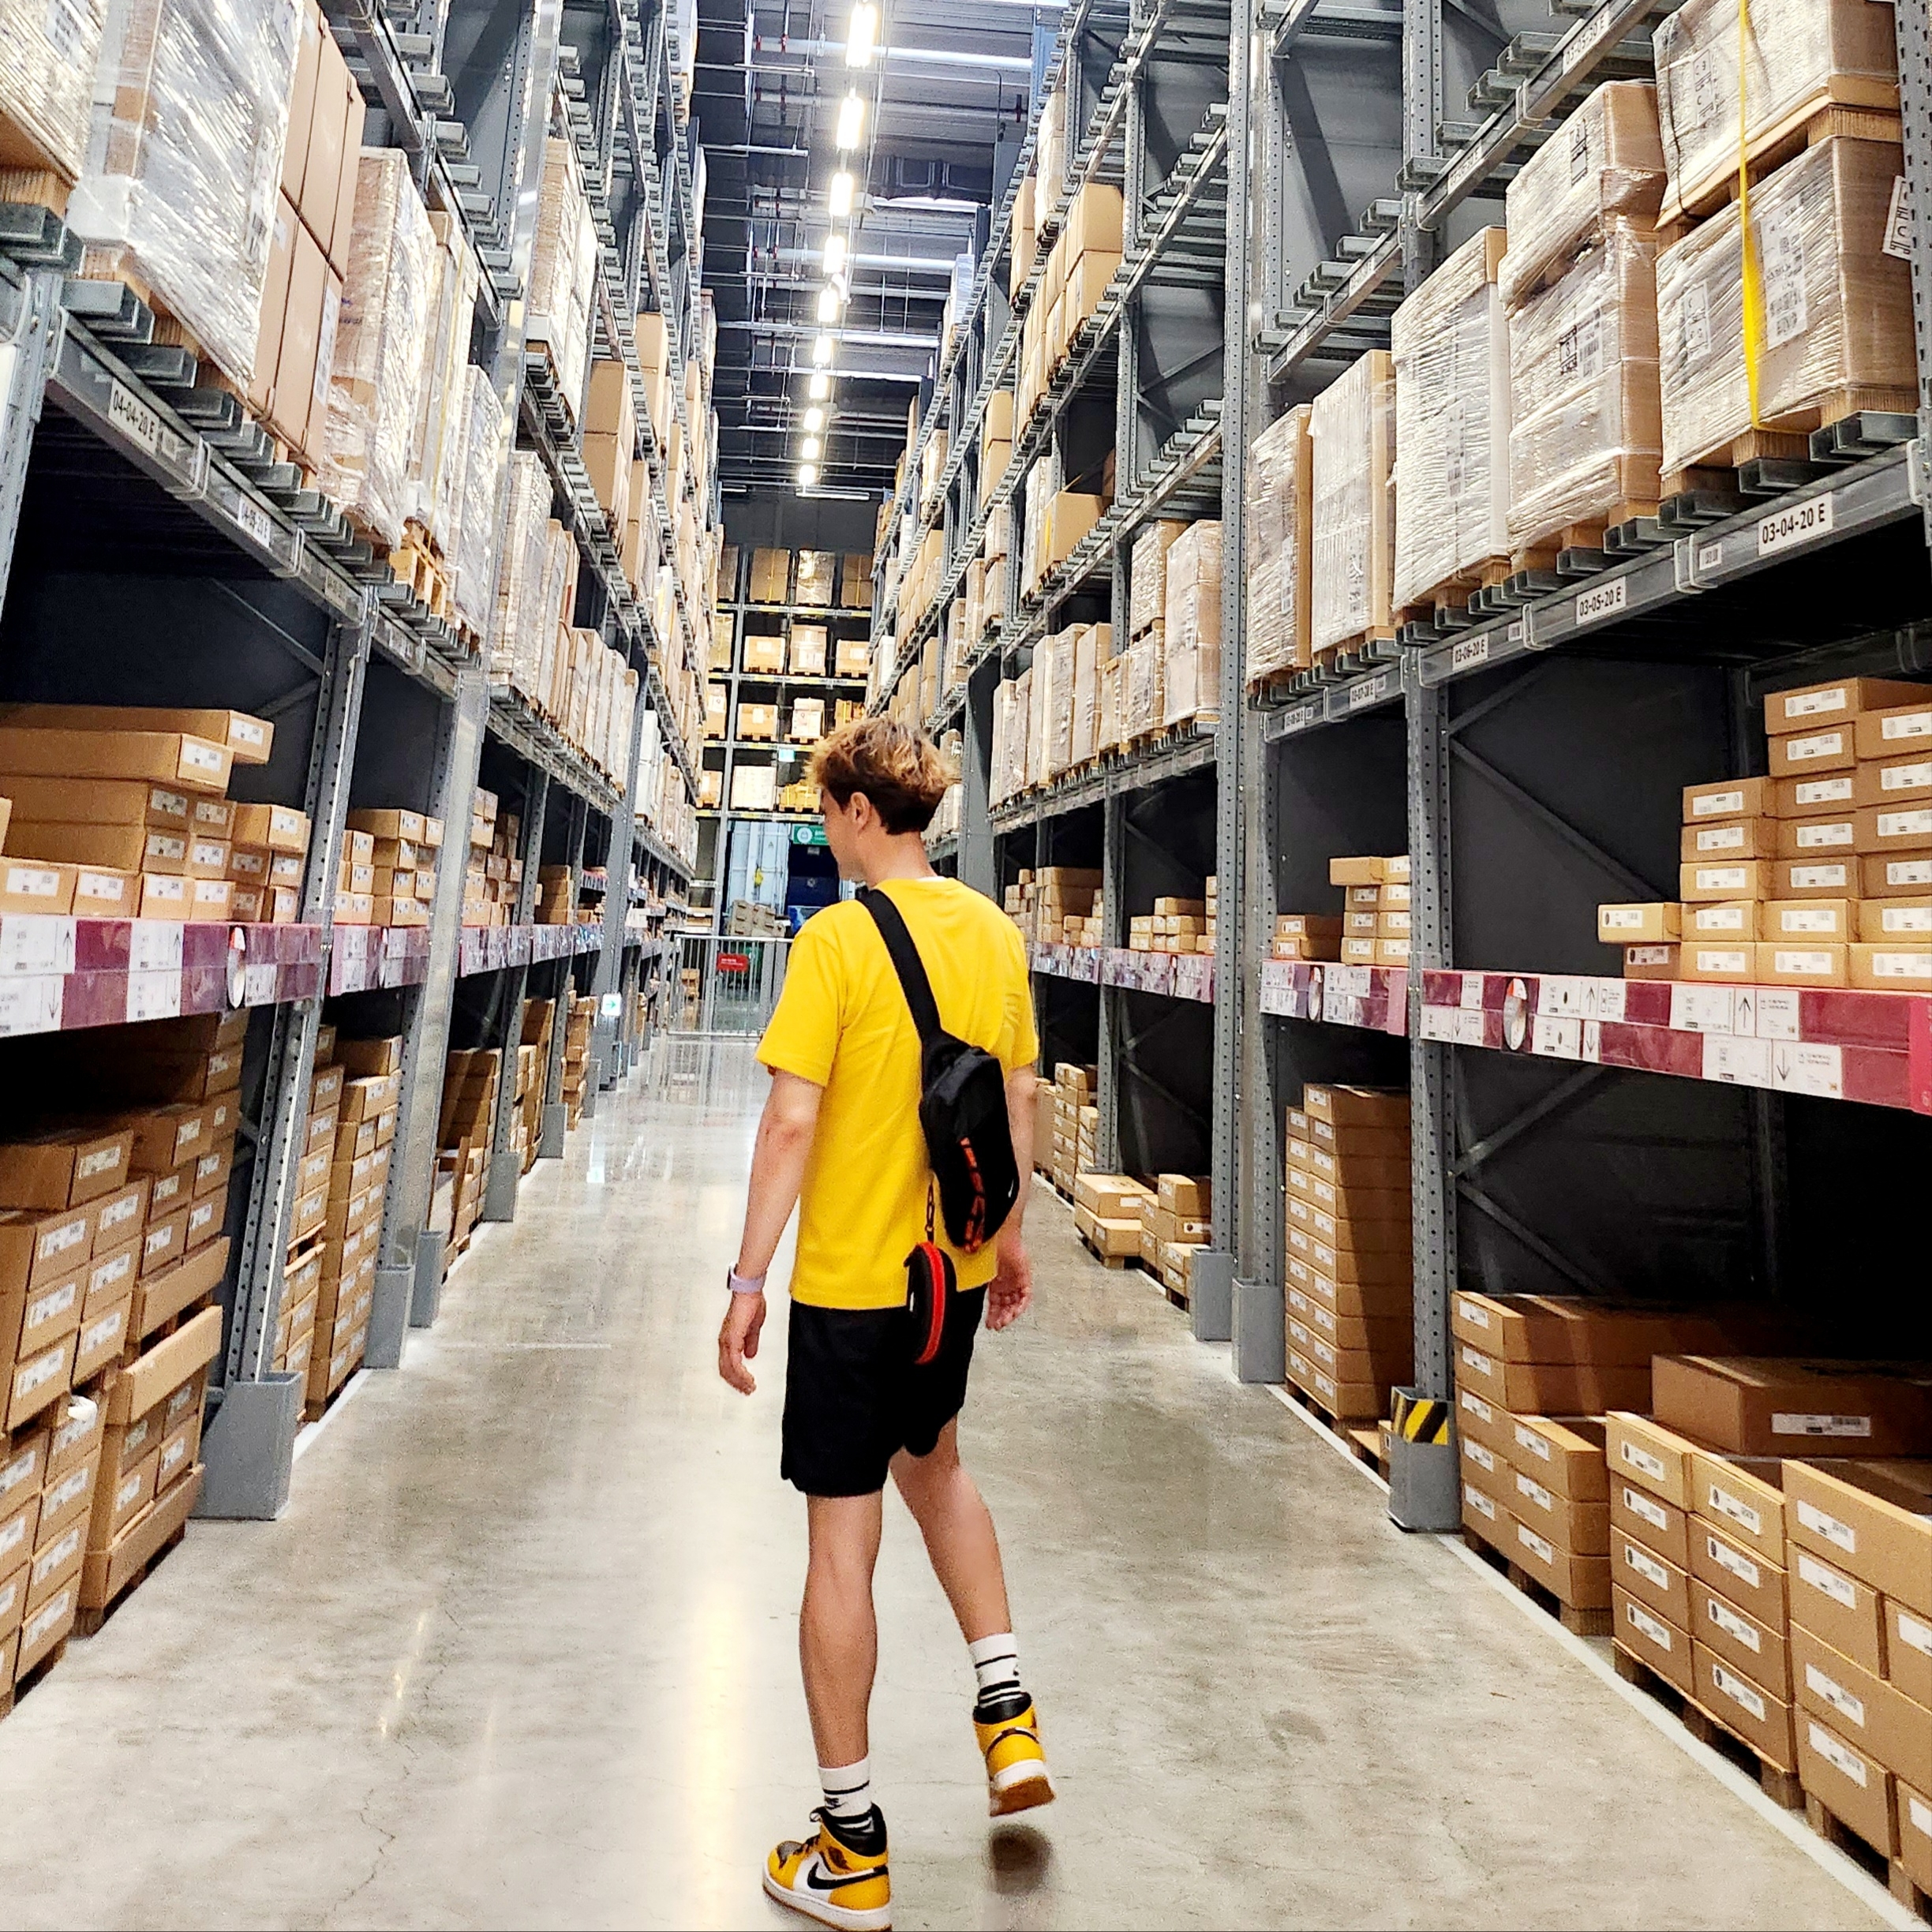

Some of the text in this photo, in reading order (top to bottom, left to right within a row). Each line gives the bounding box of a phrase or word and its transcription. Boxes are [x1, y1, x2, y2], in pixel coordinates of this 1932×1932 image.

[113, 389, 155, 442] 04-04-20 E
[1762, 503, 1825, 545] 03-04-20 E
[1579, 586, 1622, 617] 03-05-20 E
